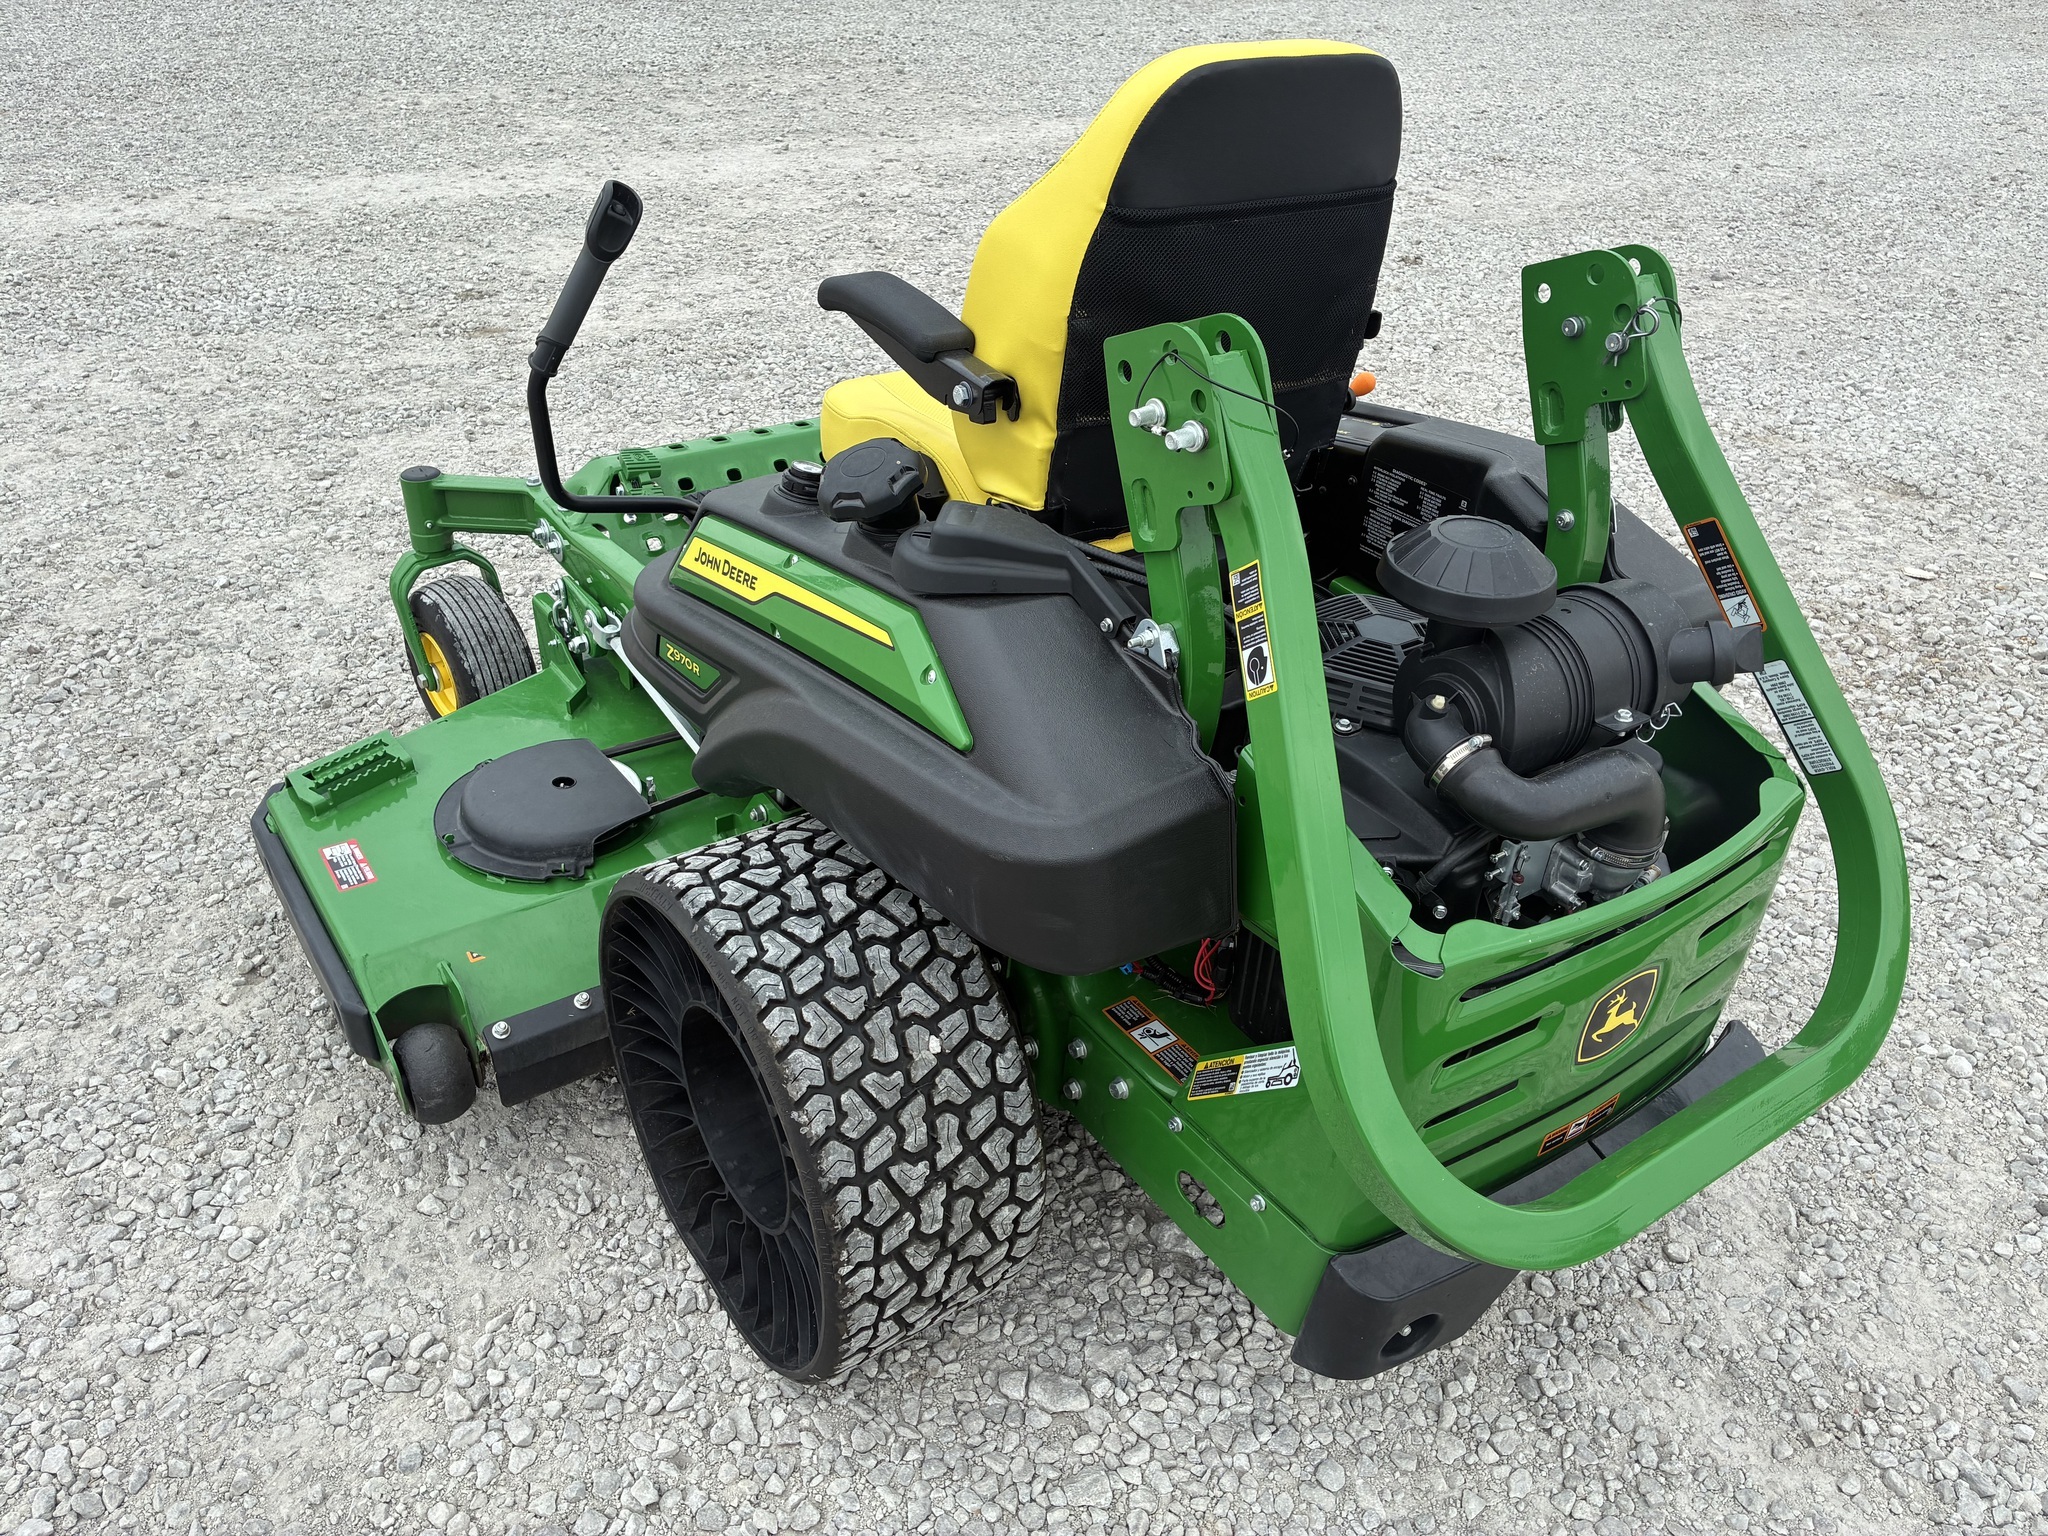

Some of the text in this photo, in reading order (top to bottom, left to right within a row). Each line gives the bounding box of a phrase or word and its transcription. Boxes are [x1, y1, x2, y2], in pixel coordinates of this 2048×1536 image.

[1393, 469, 1414, 481] DIAGNOSTIC
[694, 547, 758, 592] JOHN DEERE
[1235, 604, 1258, 619] ATENCIÓN
[665, 644, 701, 677] Z970R
[1248, 686, 1270, 698] CAUTION
[731, 997, 746, 1017] NOT
[744, 1020, 758, 1041] FOR
[755, 1043, 780, 1094] HIGHWAY
[1208, 1057, 1235, 1068] ATENCIÓN
